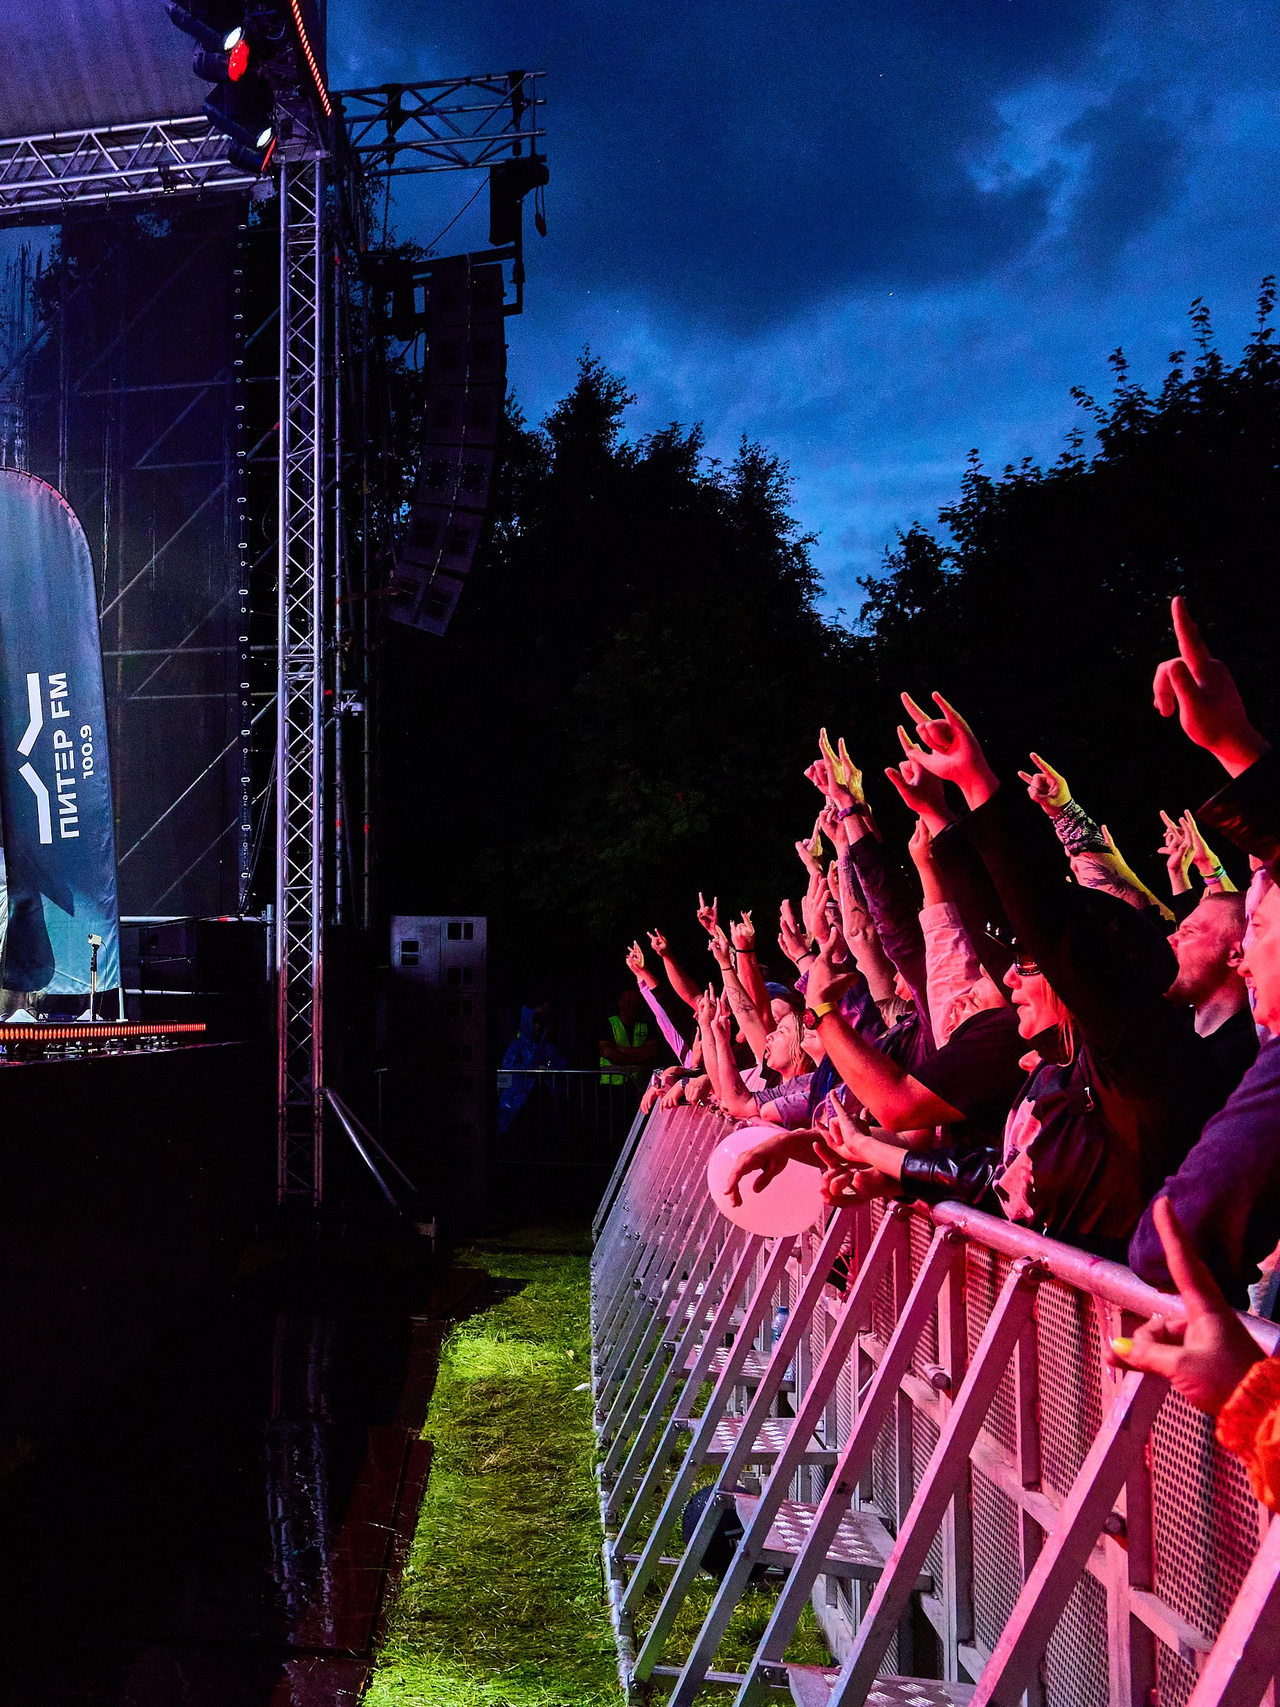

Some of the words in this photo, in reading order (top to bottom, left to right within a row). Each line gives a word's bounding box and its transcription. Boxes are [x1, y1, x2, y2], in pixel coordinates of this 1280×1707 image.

[48, 672, 71, 719] FM
[80, 724, 95, 780] 100.9
[53, 728, 80, 839] ПИТЕР
